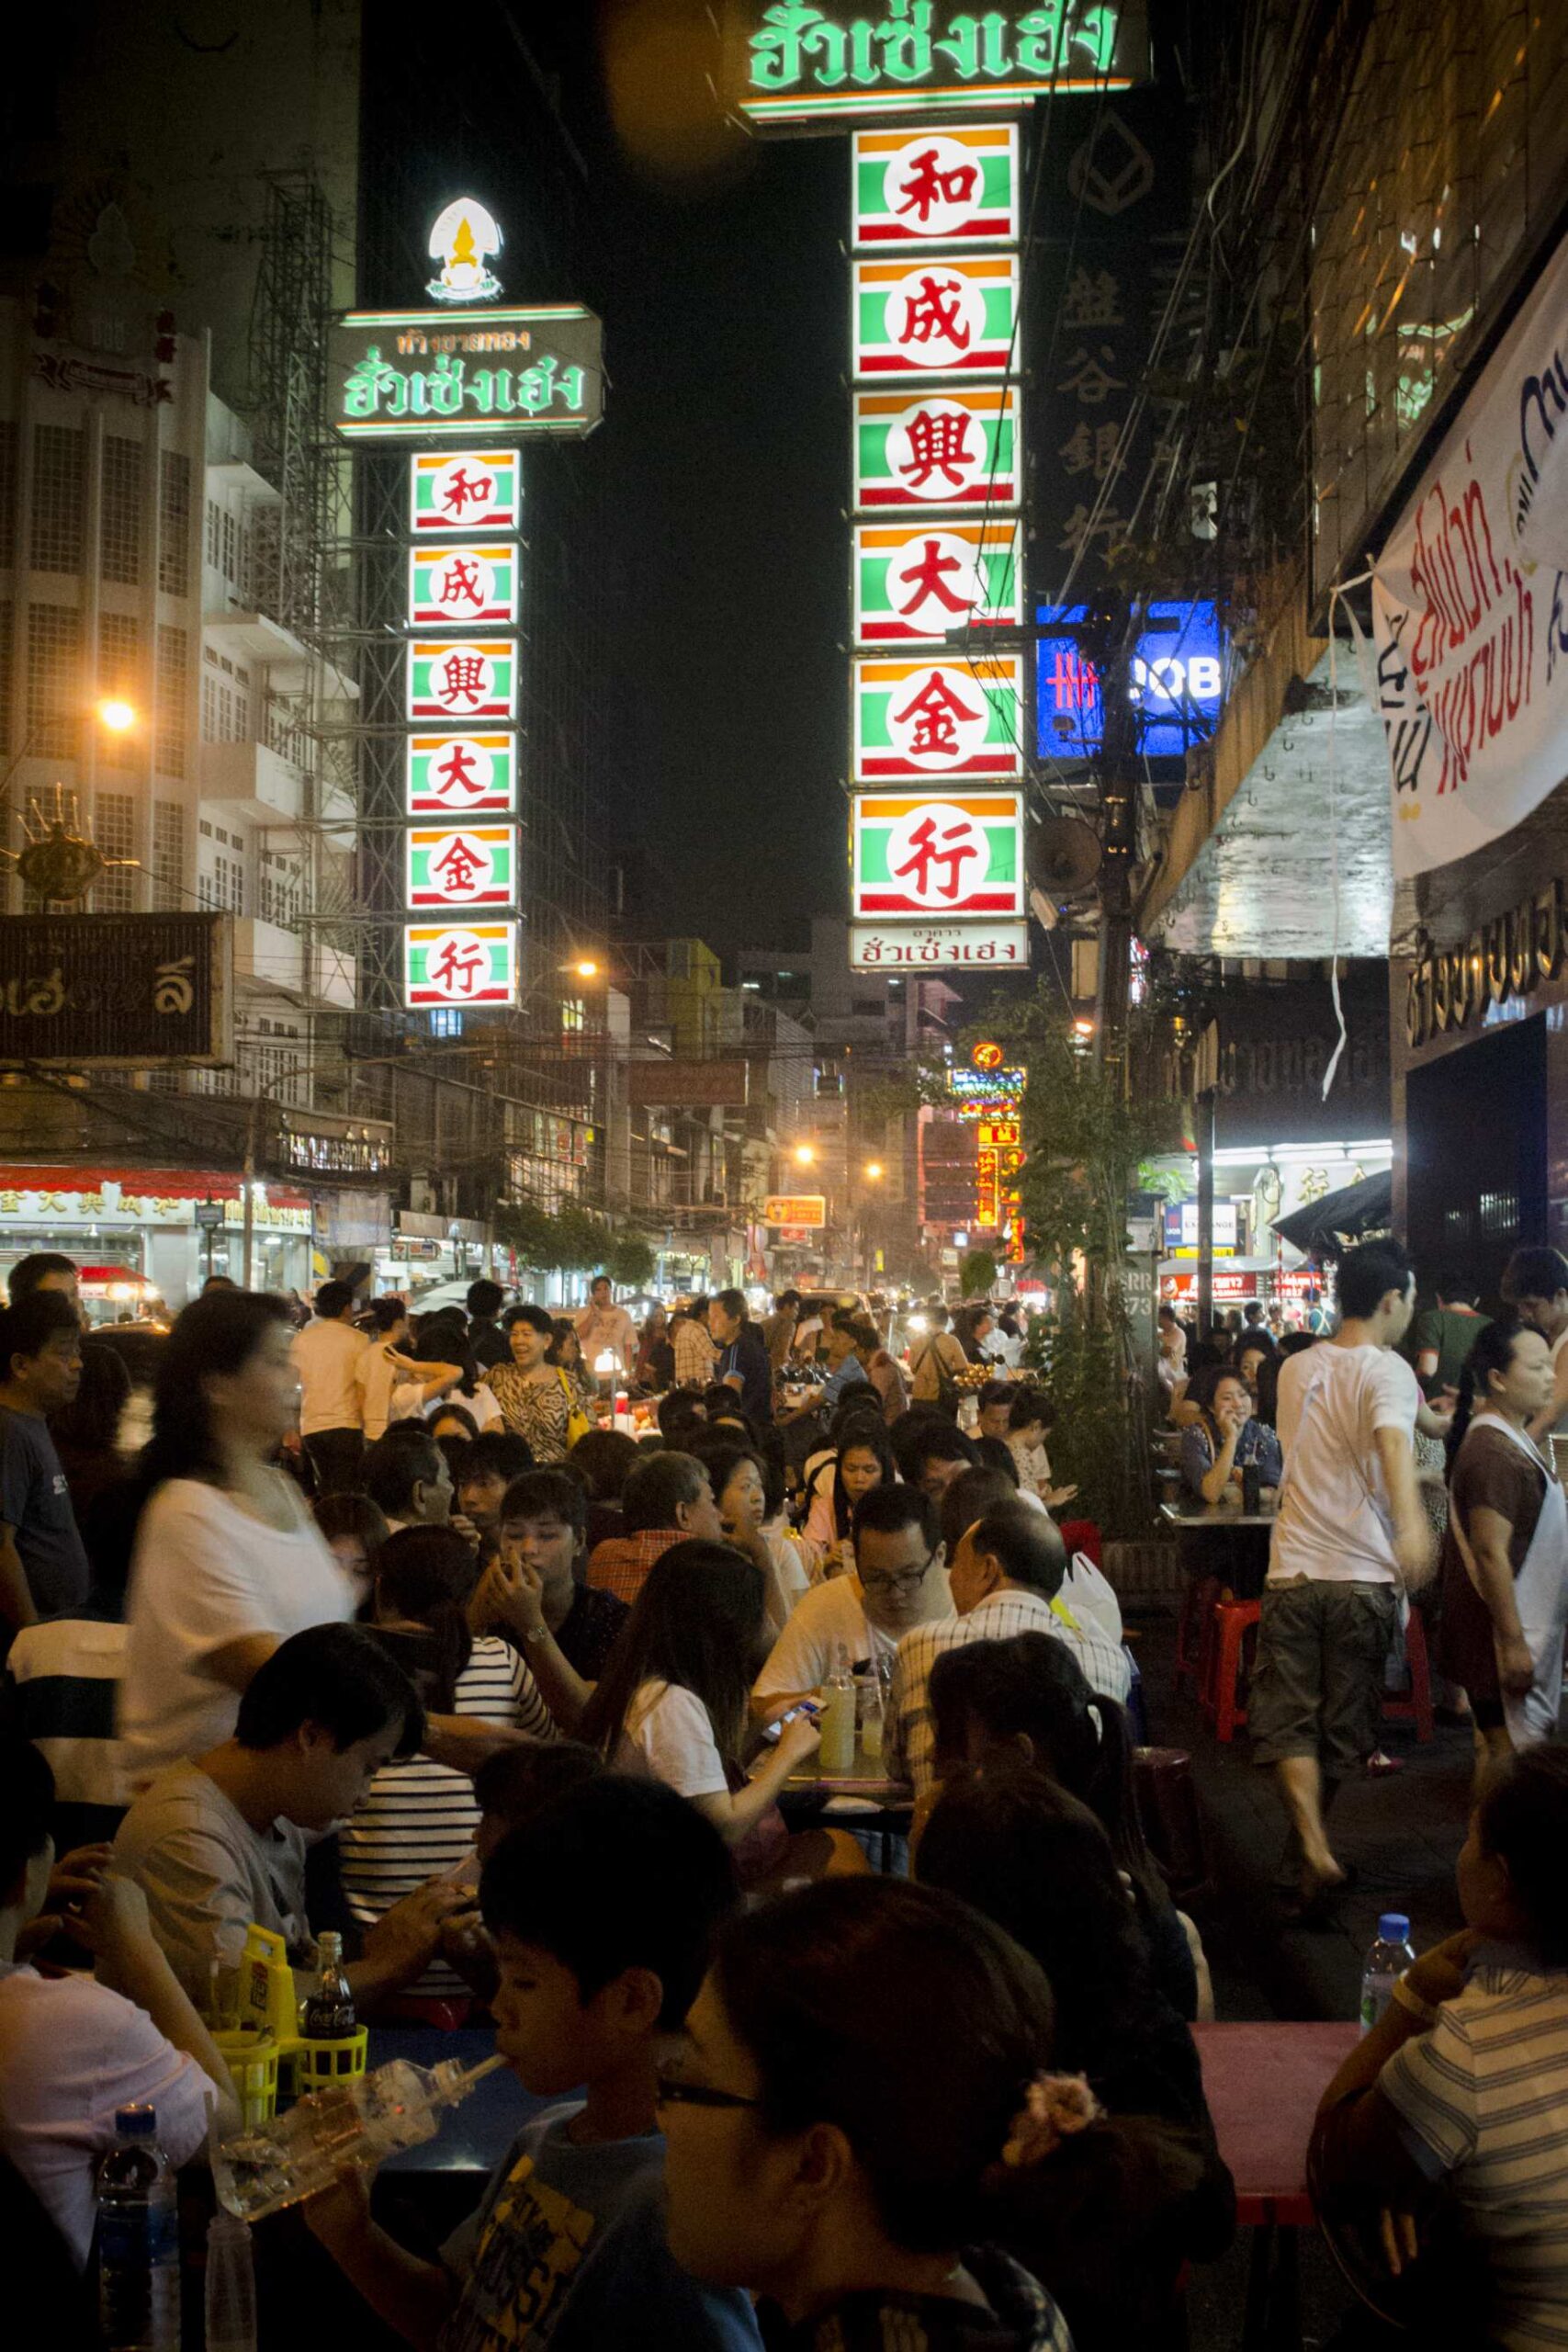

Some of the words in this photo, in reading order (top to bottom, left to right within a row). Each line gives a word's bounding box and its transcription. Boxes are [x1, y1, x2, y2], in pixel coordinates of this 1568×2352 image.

[748, 0, 1119, 89] ฮัวเซ่งเฮง
[431, 468, 492, 993] 和成興大金行
[894, 149, 983, 900] 和成興大金行
